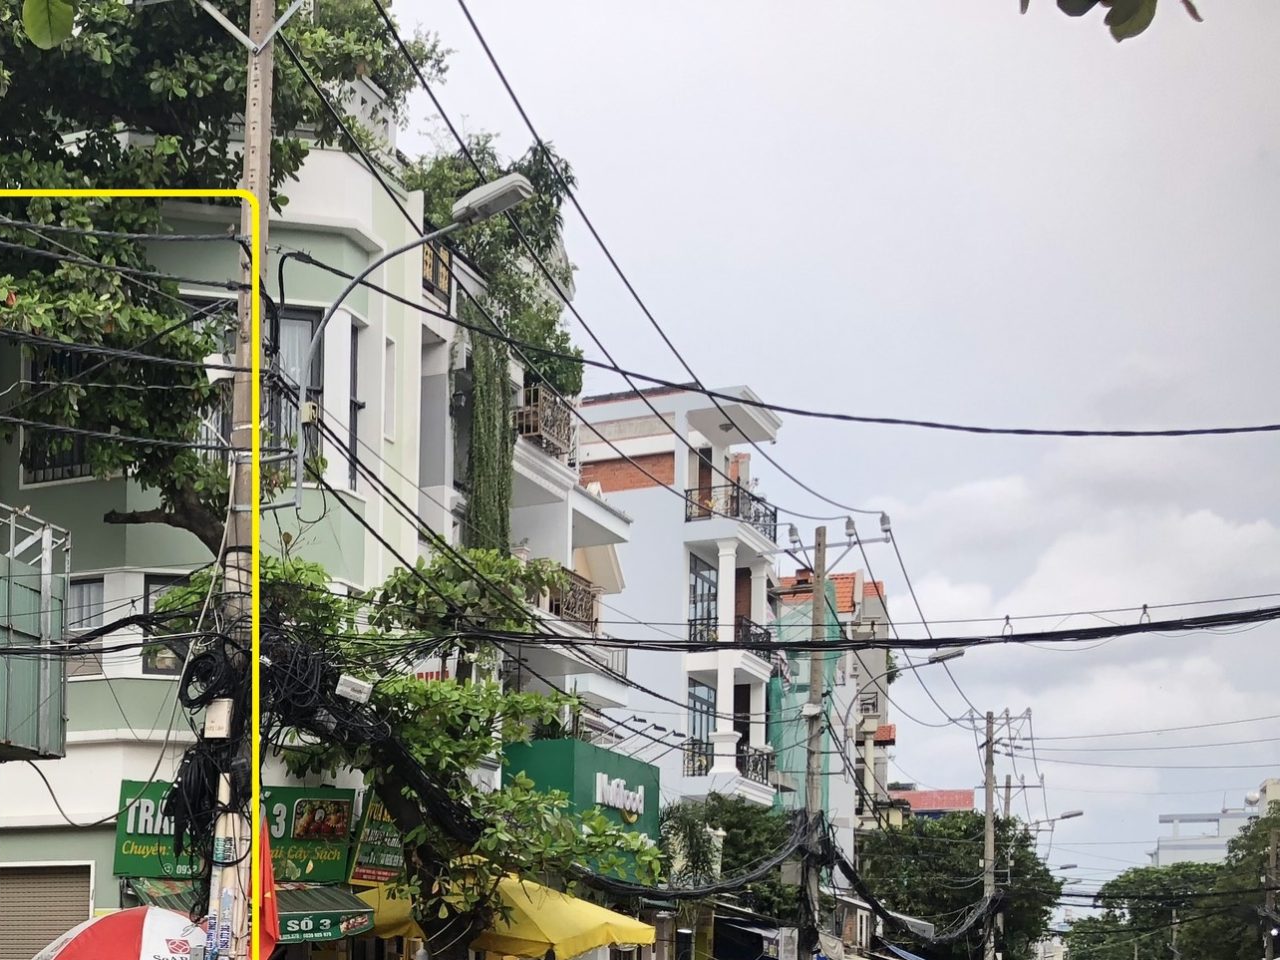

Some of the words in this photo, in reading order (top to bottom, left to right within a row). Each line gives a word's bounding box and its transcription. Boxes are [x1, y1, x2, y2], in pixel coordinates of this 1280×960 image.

[270, 802, 287, 838] 3
[286, 915, 314, 931] SỐ
[319, 918, 332, 930] 3
